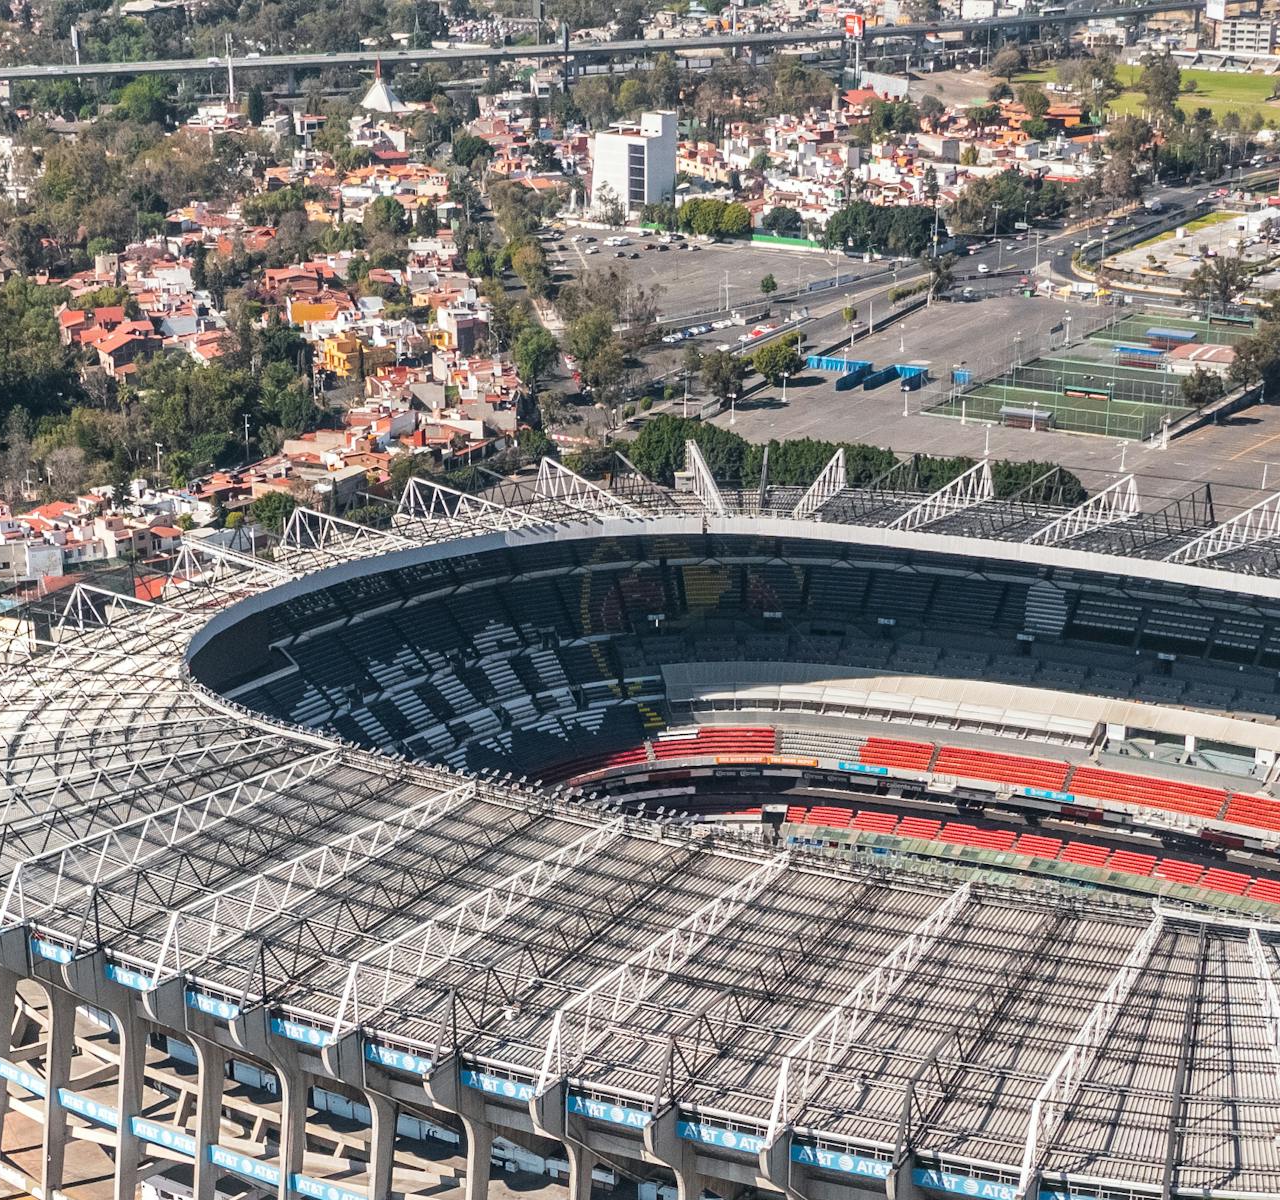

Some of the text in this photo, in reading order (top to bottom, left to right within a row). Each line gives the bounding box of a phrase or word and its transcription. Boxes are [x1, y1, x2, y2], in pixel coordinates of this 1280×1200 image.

[191, 991, 214, 1013] AT&T
[278, 1018, 305, 1039] AT&T
[371, 1044, 398, 1065] AT&T
[469, 1071, 497, 1094] AT&T
[574, 1096, 651, 1128] AT&T AT&
[135, 1123, 160, 1139] AT&T
[684, 1122, 768, 1152] AT&T AT&
[214, 1151, 280, 1182] AT&T AT&T
[799, 1146, 833, 1167] AT&T
[298, 1181, 323, 1197] AT&T
[922, 1169, 957, 1191] AT&T
